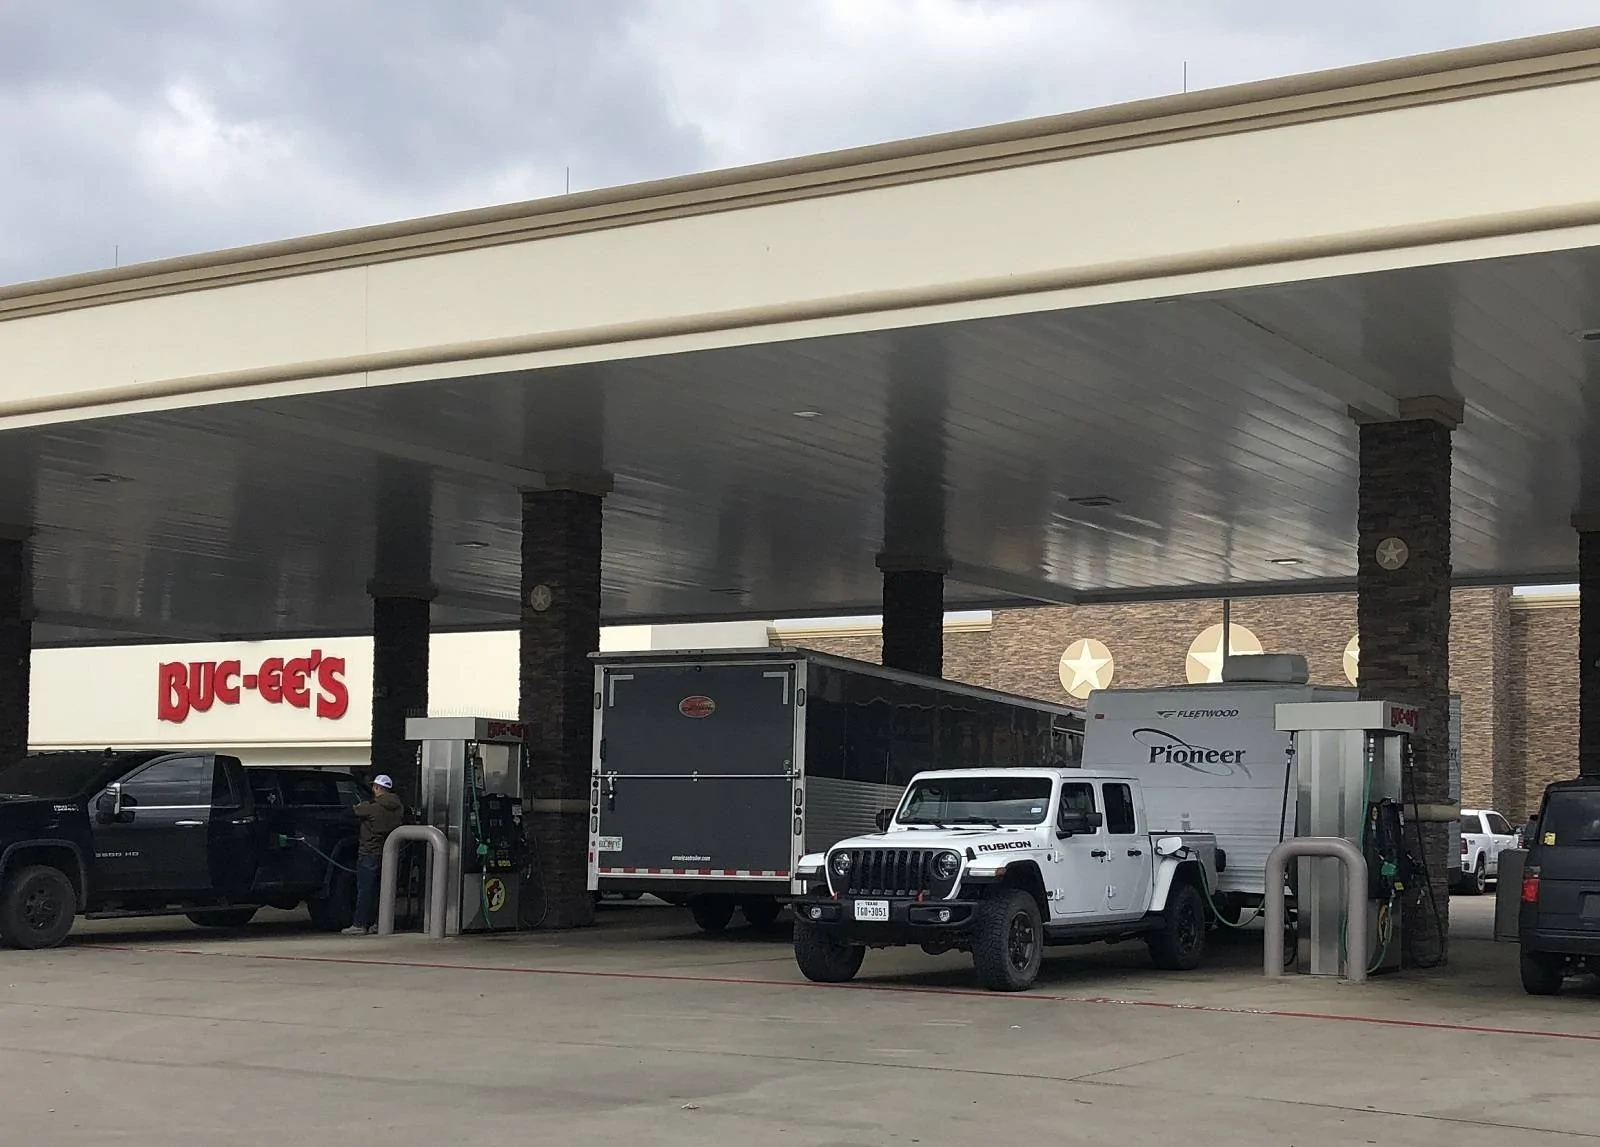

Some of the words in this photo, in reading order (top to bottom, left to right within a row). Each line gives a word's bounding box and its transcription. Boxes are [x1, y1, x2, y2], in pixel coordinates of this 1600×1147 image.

[158, 648, 349, 724] BUC-EE'S
[1177, 709, 1239, 719] FLEETWOOD
[1149, 744, 1247, 764] Pioneer
[978, 840, 1032, 852] RUBICON
